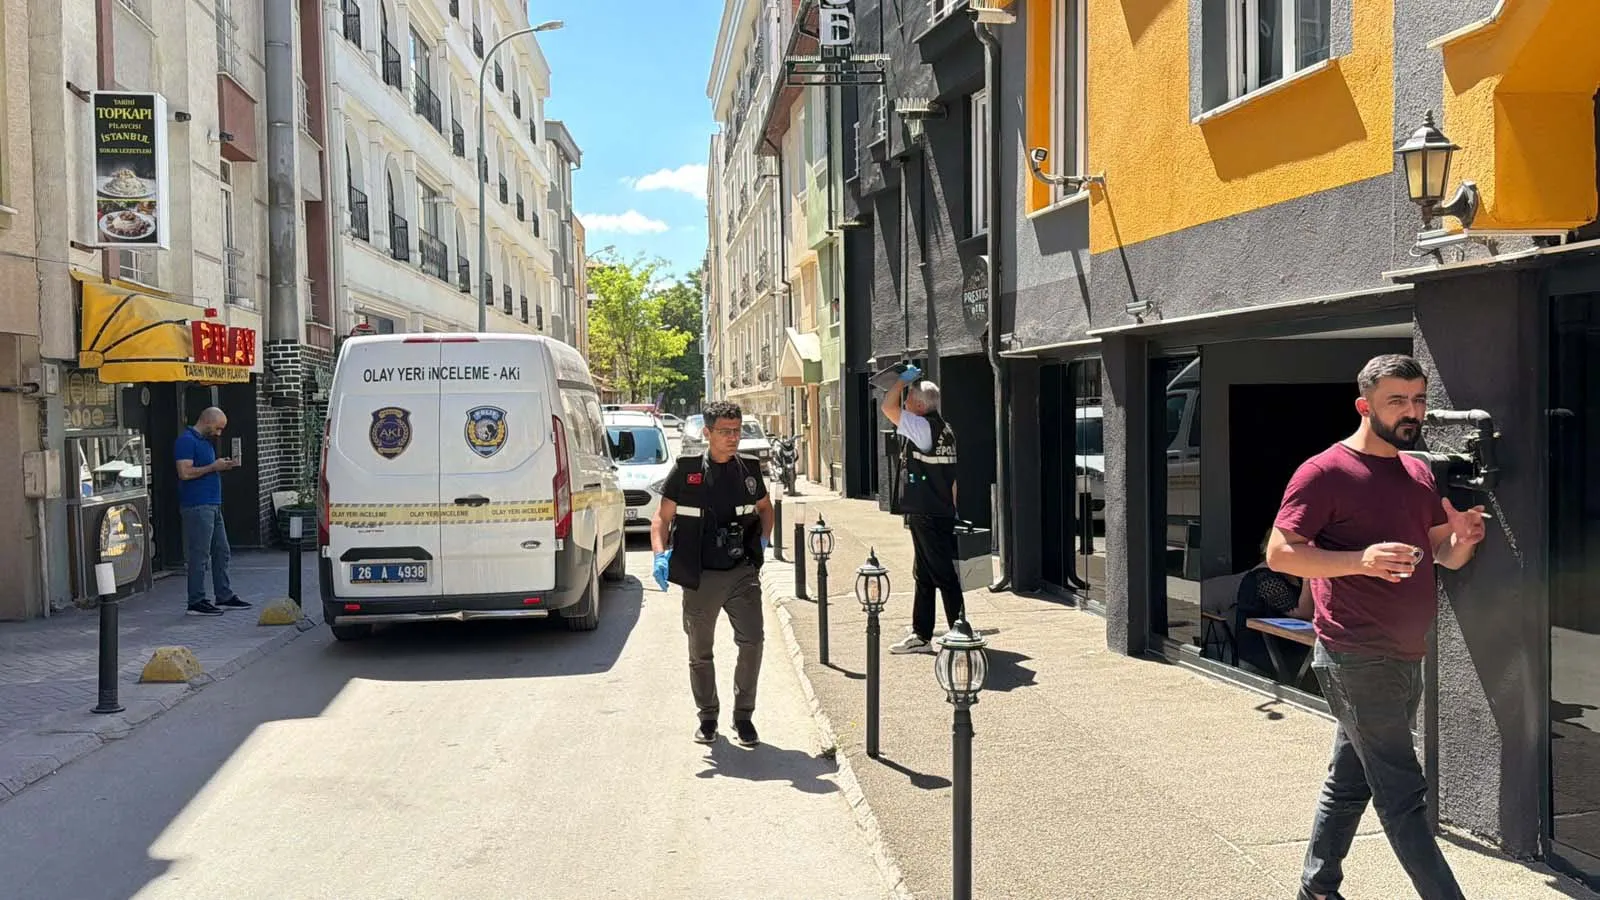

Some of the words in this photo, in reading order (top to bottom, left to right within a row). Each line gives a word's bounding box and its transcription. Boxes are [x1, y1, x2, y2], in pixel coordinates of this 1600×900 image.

[96, 107, 152, 119] TOPKAPI
[101, 132, 150, 144] İSTANBUL
[963, 288, 988, 304] PRESTIG
[364, 368, 395, 382] OLAY
[358, 566, 372, 579] 26
[381, 566, 388, 578] A
[397, 565, 424, 578] 4938
